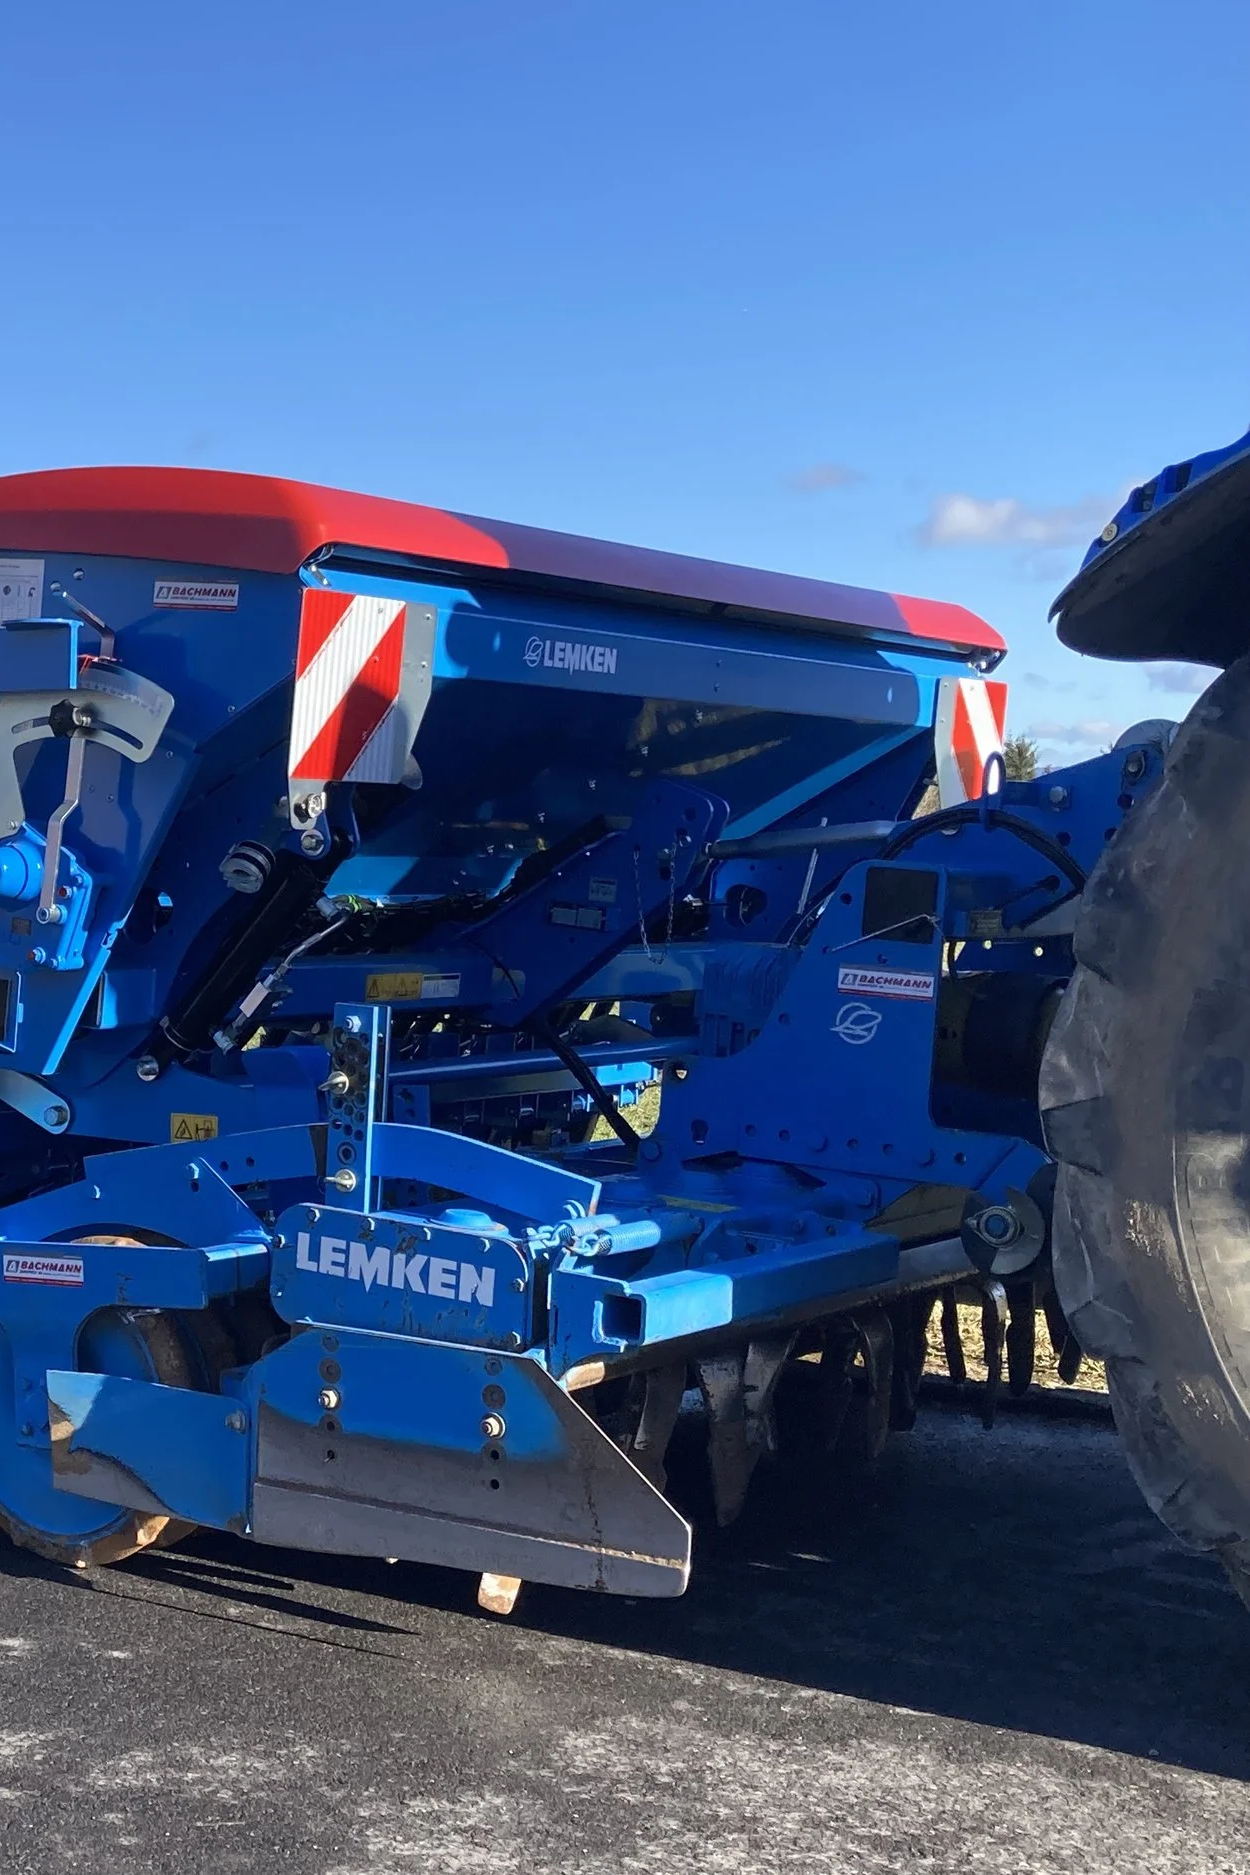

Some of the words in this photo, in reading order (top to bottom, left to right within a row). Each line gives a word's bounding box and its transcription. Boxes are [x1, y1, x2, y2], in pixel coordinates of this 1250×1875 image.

[172, 587, 237, 598] BACHMANN
[544, 640, 618, 675] LEMKEN
[858, 975, 932, 989] BACHMANN
[21, 1261, 82, 1273] BACHMANN
[296, 1232, 496, 1307] LEMKEN
